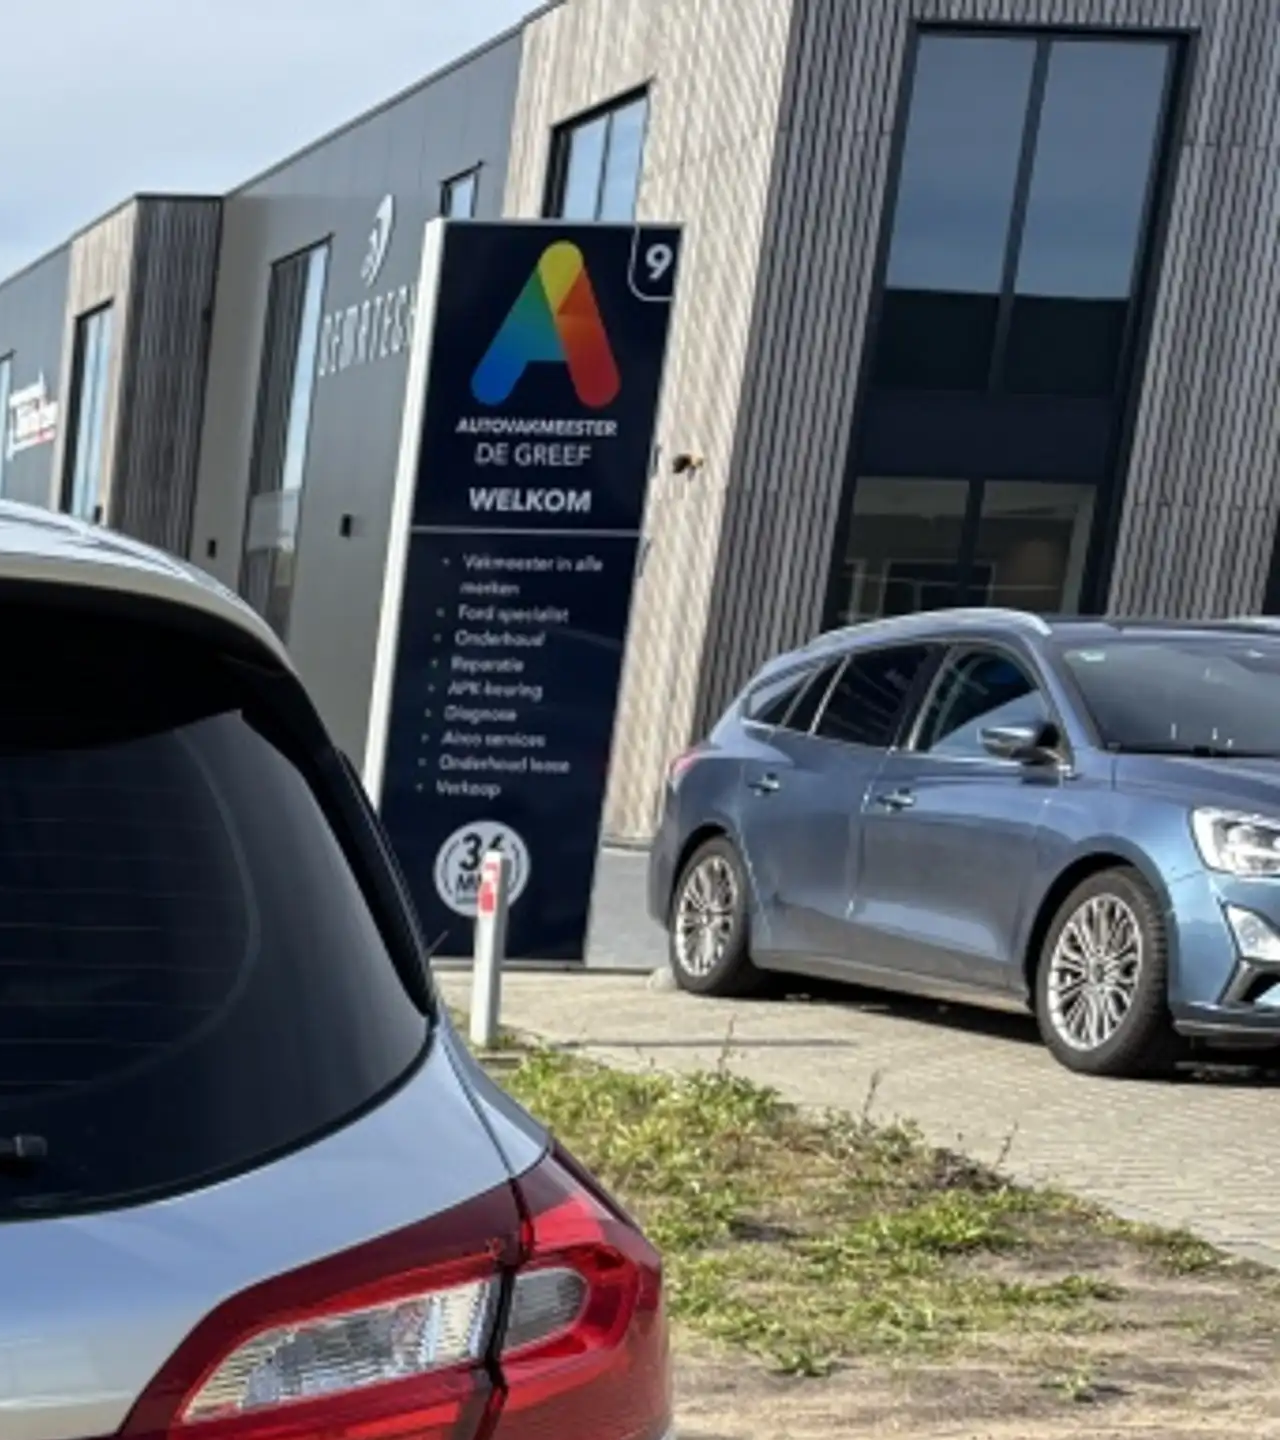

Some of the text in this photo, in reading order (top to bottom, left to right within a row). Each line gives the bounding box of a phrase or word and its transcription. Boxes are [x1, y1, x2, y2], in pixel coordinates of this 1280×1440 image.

[645, 243, 673, 280] 9
[455, 417, 618, 437] AUTOVAKMEESTER
[474, 443, 592, 467] DE GREEF
[468, 487, 592, 512] WELKOM
[462, 554, 604, 572] Vakmeester in alle
[459, 581, 520, 596] merken
[458, 603, 569, 625] Ford specialist
[454, 629, 547, 647] Onderhoud
[450, 655, 525, 676] Reparatie
[447, 680, 543, 702] APK keuring
[443, 704, 517, 725] Diagnose
[438, 753, 571, 774] Onderhoud lease
[436, 779, 502, 800] Verkoop
